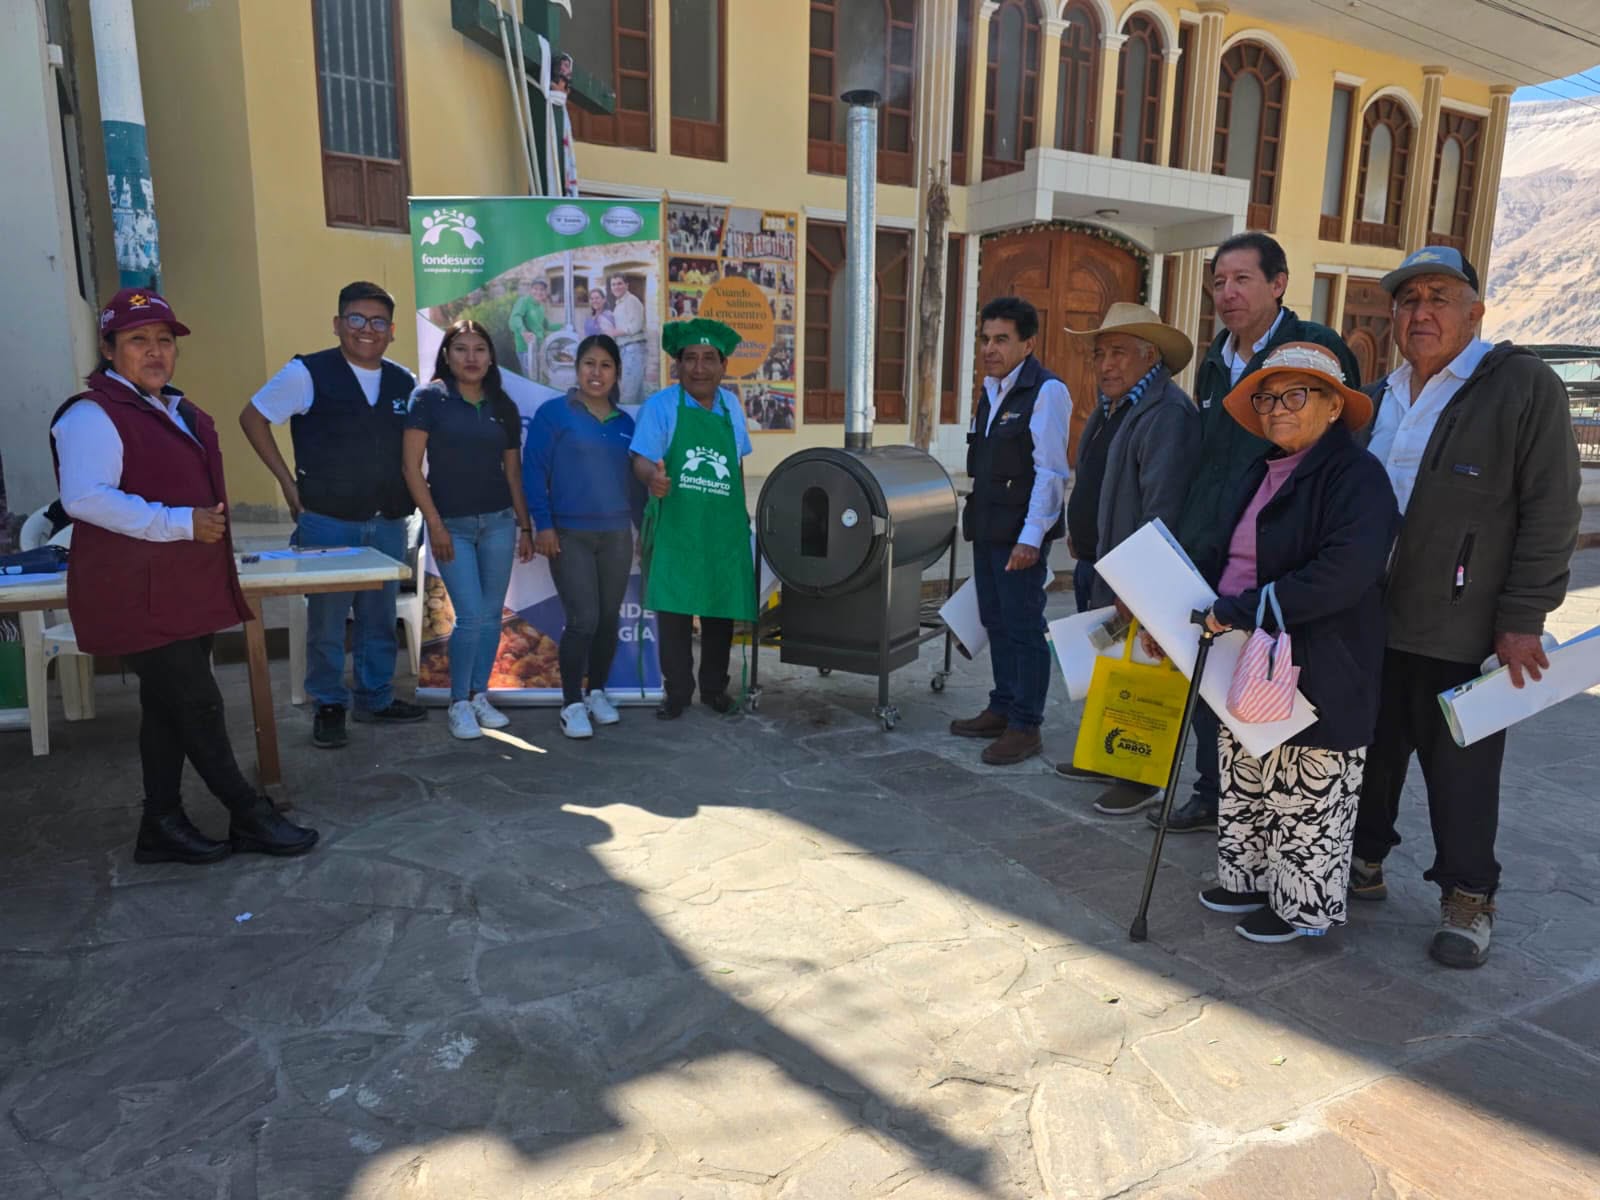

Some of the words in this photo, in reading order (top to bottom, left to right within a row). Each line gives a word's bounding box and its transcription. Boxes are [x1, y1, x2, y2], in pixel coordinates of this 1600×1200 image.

[422, 253, 485, 265] fondesurco
[703, 307, 713, 318] al
[716, 310, 767, 320] encuentro
[680, 473, 731, 490] fondesurco
[1117, 742, 1153, 755] ARROZ
